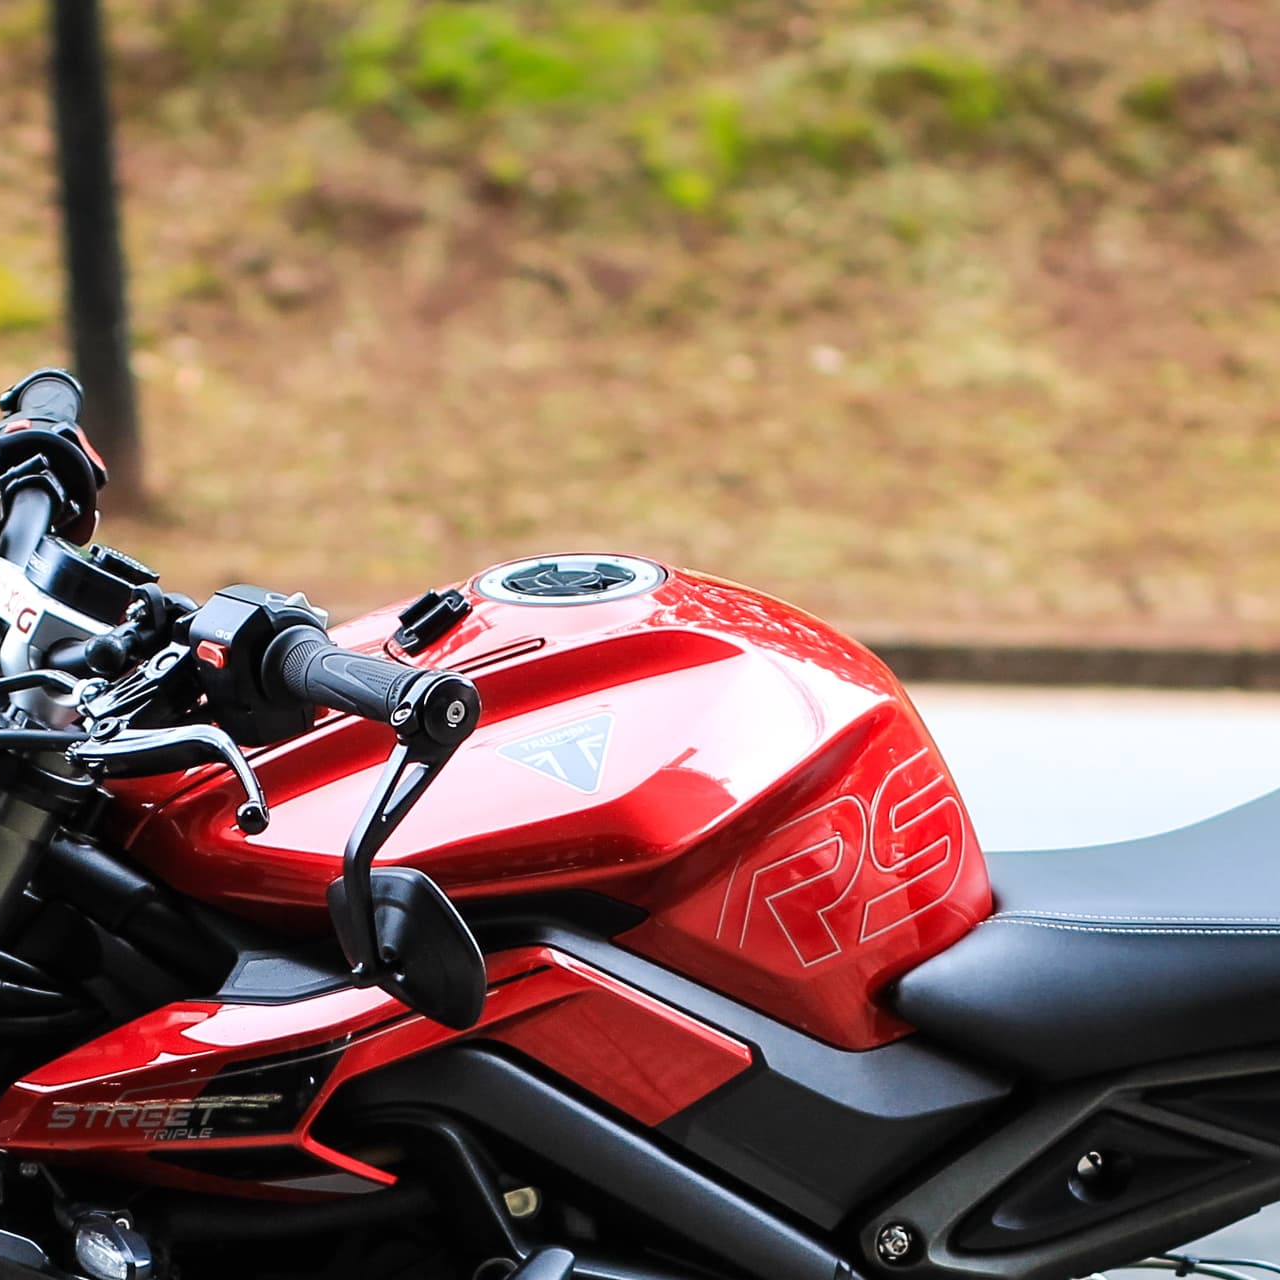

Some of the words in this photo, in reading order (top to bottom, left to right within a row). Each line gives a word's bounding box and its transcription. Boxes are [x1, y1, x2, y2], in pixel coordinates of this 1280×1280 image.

[716, 747, 965, 968] RS
[47, 1102, 224, 1129] STREET
[143, 1127, 214, 1141] TRIPLE
